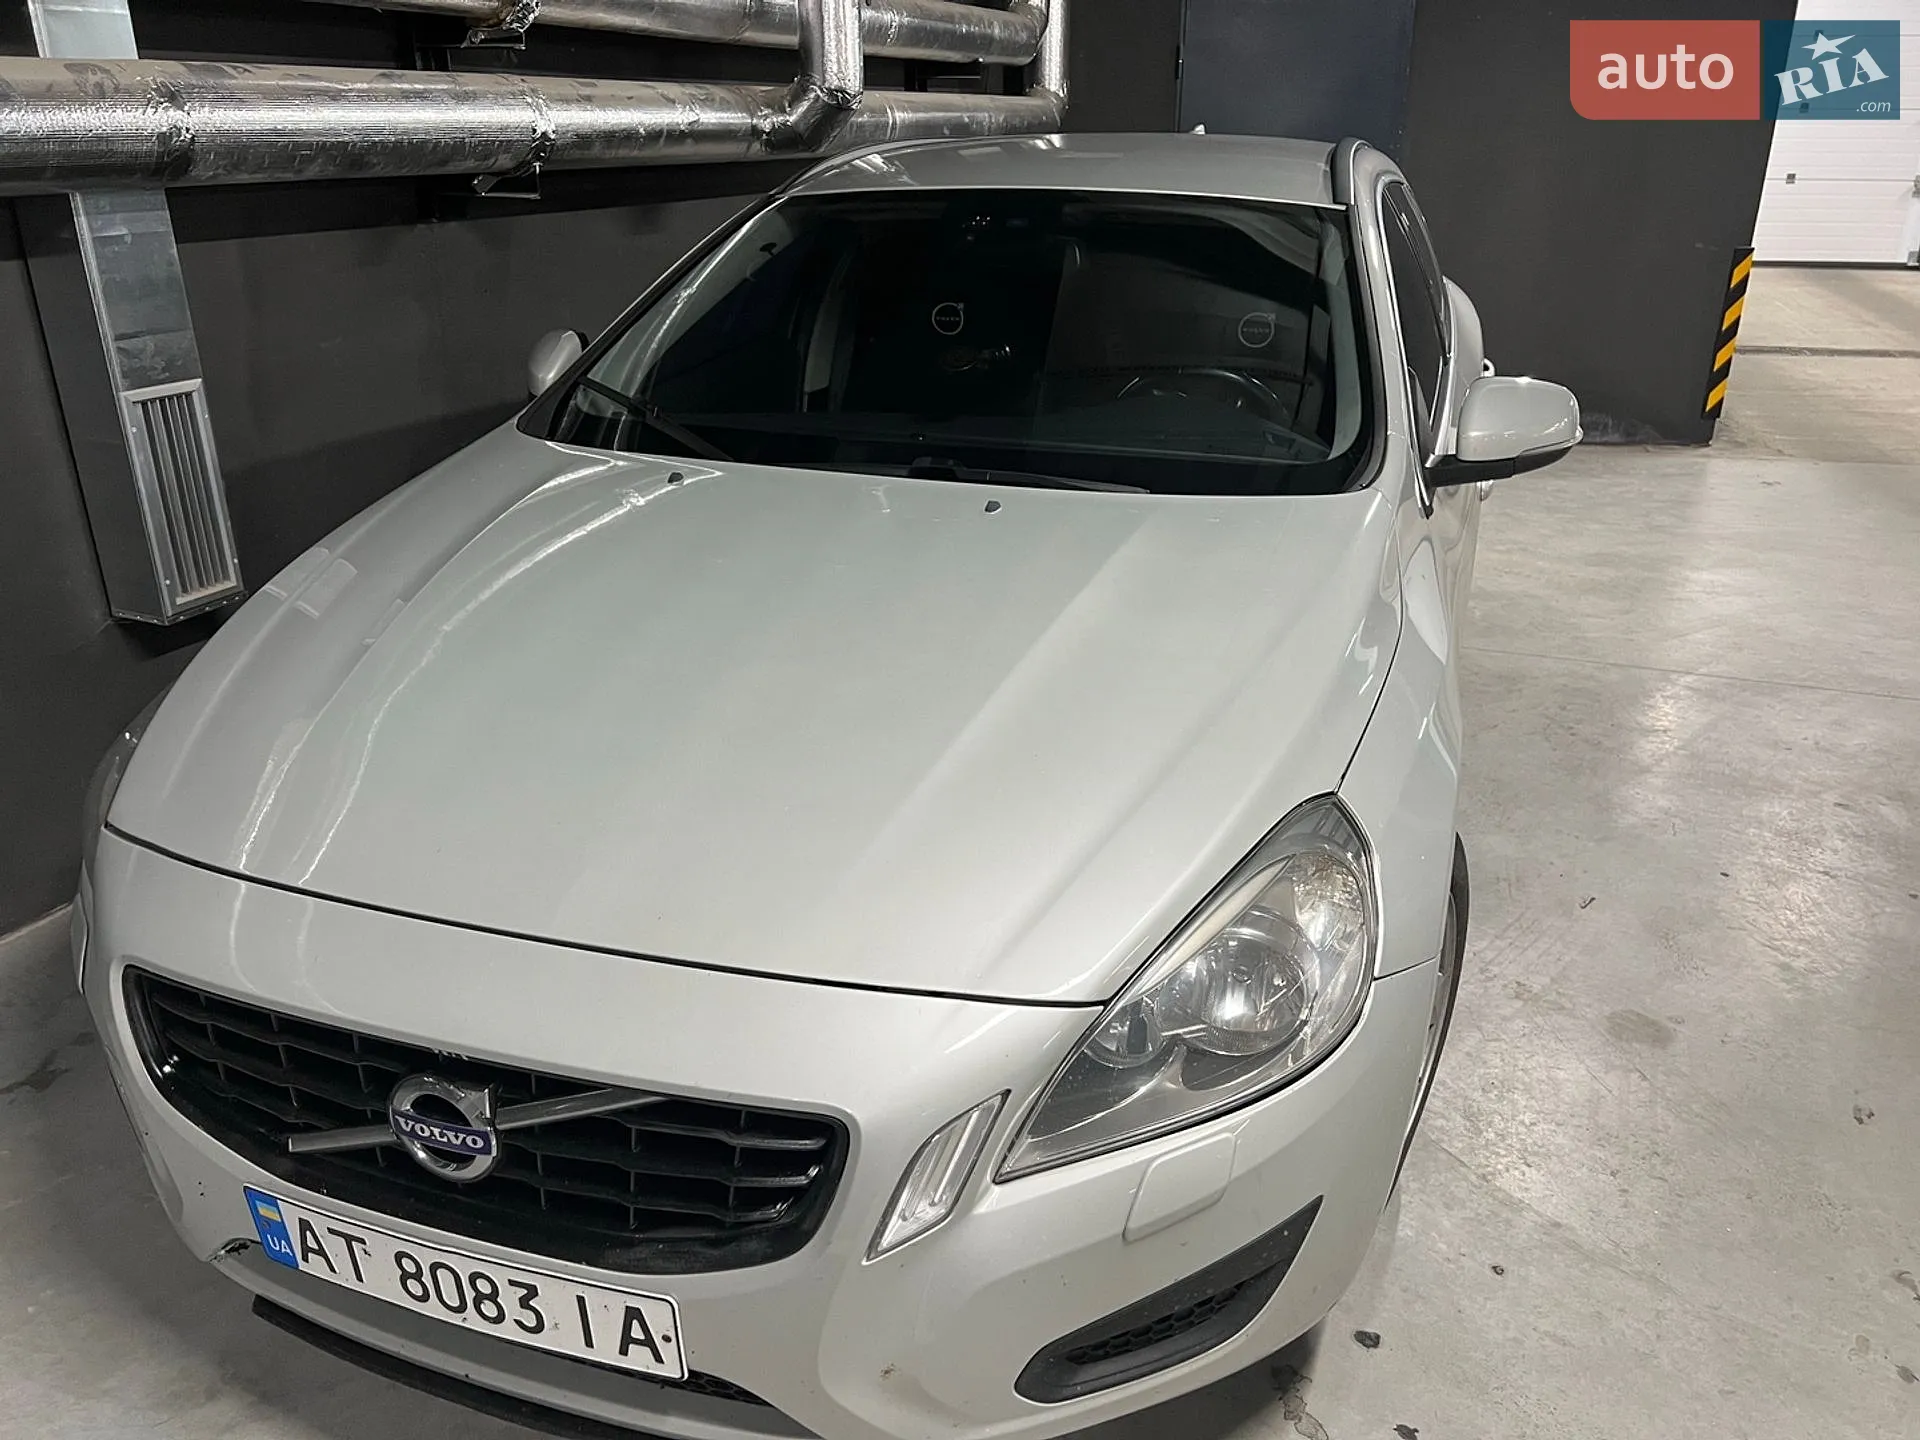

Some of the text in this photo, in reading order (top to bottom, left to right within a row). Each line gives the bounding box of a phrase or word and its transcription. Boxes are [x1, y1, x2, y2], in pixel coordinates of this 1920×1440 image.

[395, 1115, 485, 1149] VOLVO
[266, 1233, 294, 1257] UA
[297, 1216, 665, 1364] AT 8083 IA
